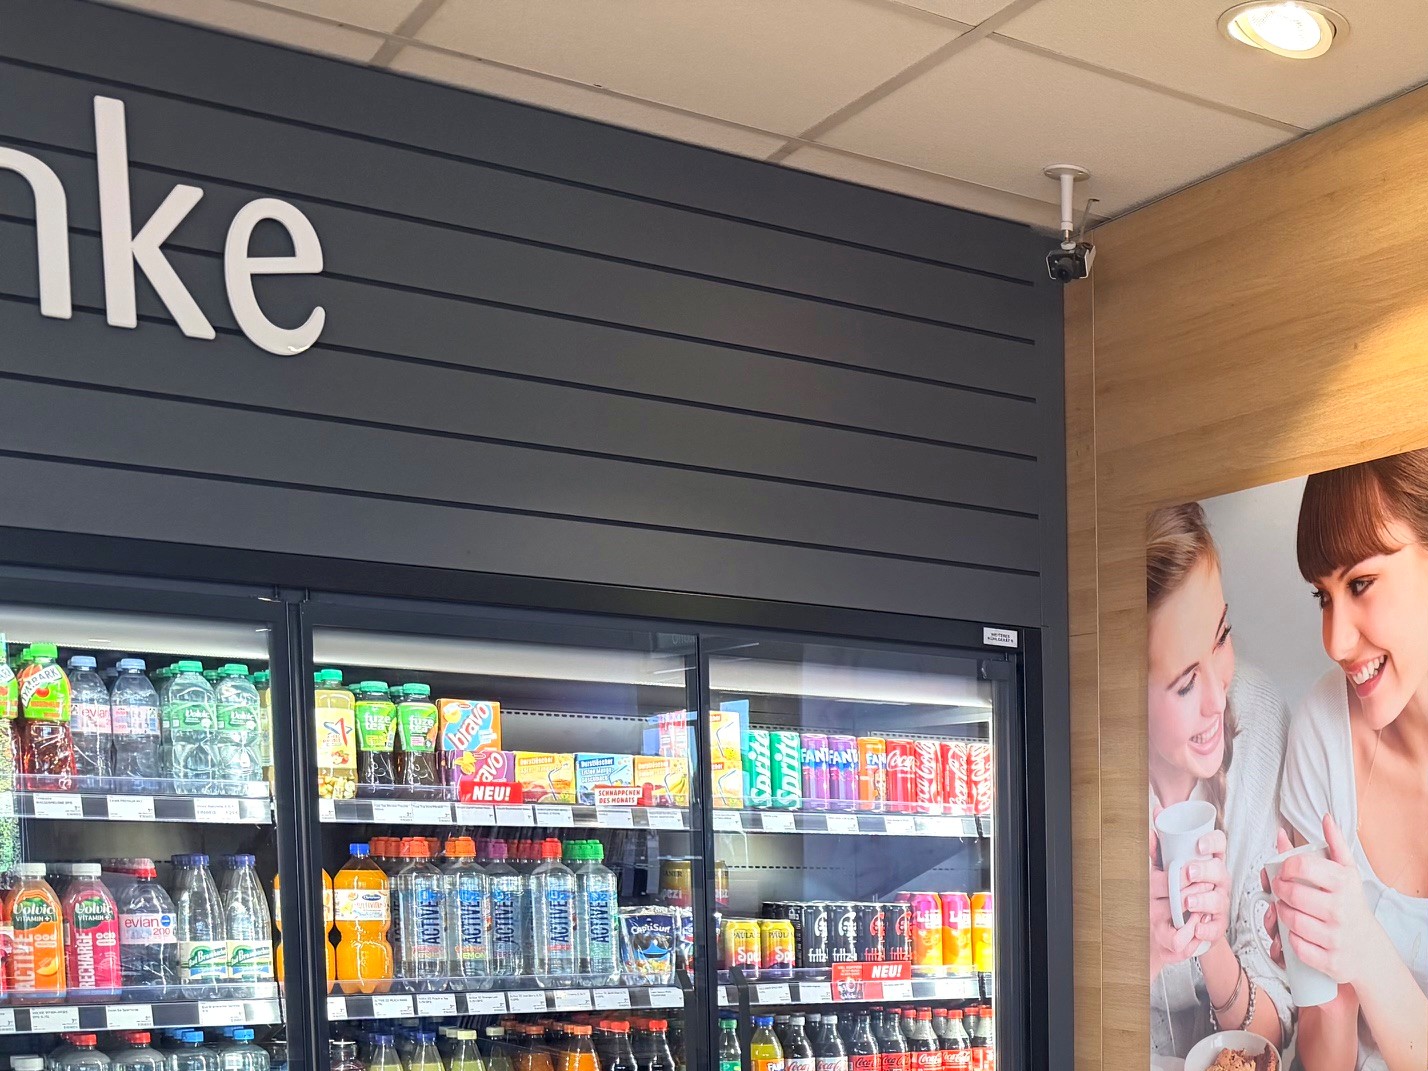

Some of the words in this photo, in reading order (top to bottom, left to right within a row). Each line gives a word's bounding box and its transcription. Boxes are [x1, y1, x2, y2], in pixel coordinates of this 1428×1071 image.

[450, 703, 490, 751] bravo
[750, 730, 770, 808] Sprite
[779, 731, 800, 808] Sprite
[472, 786, 512, 802] NEU!
[598, 789, 641, 798] SCHNÄPPCHEN
[124, 915, 160, 930] evian
[79, 932, 93, 989] RECHARGE
[871, 966, 902, 978] NEU!
